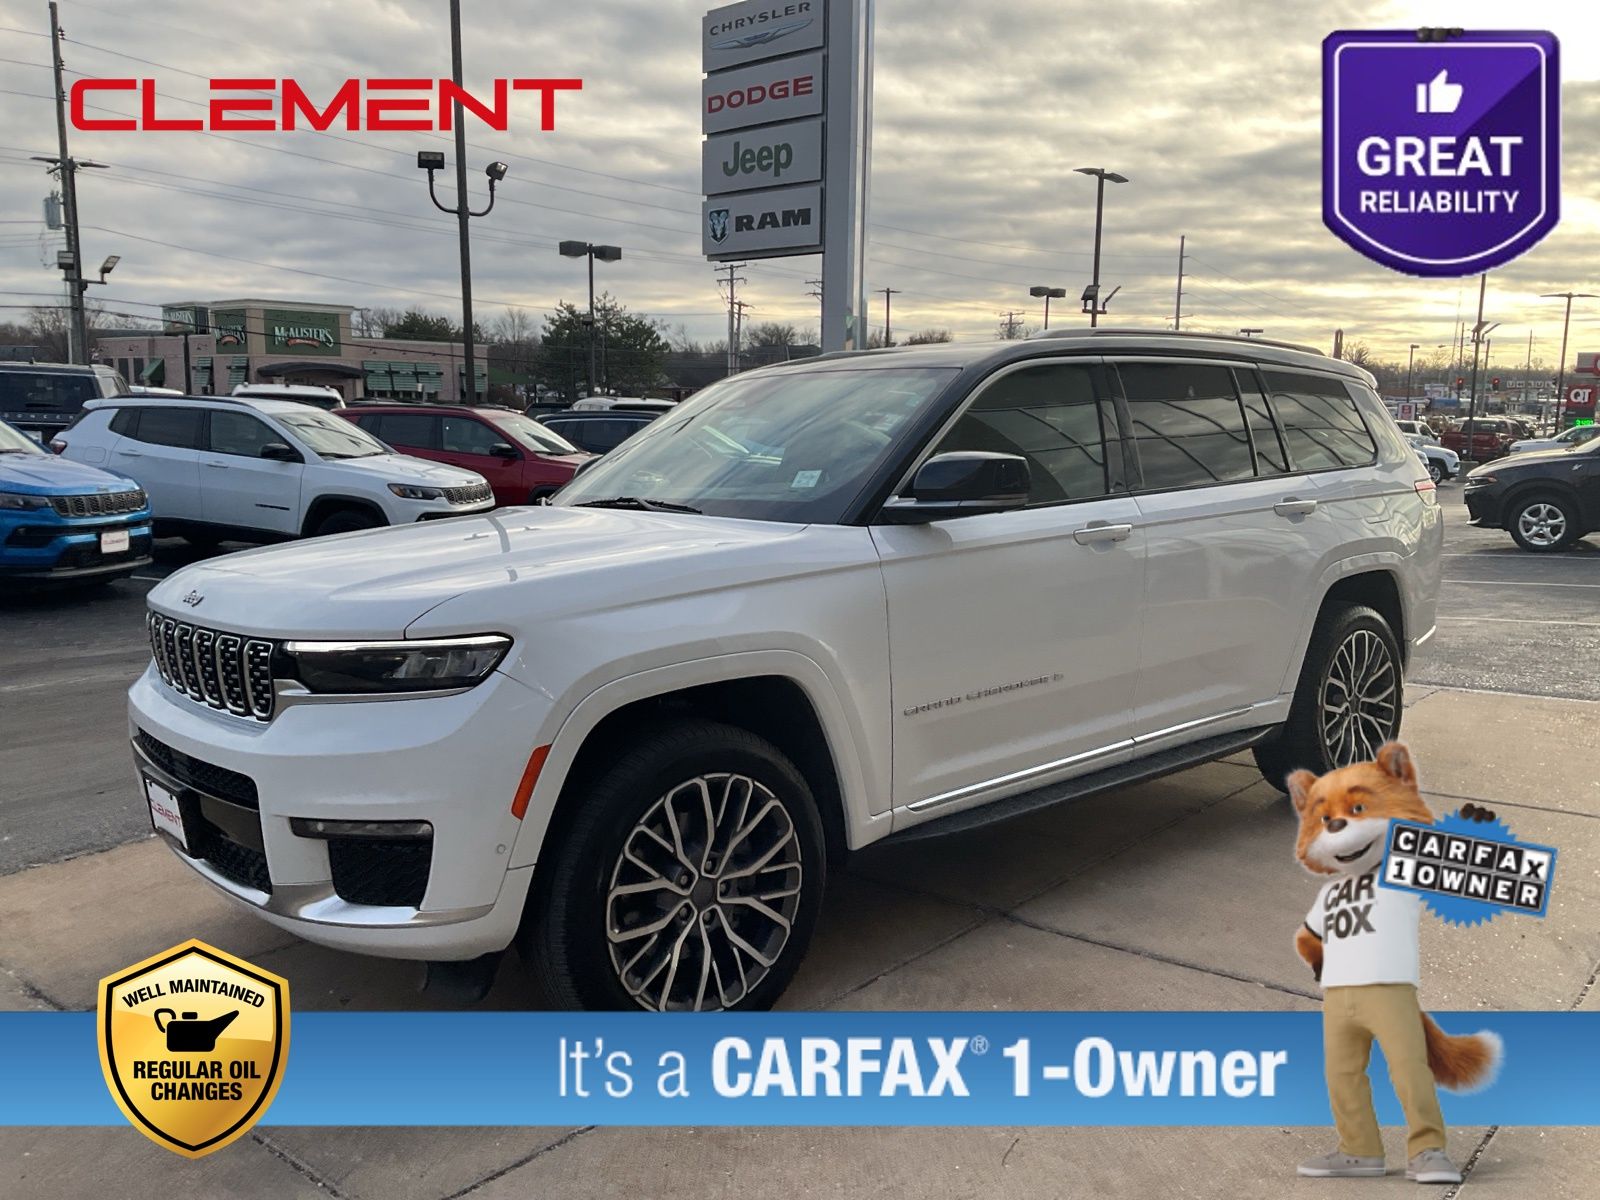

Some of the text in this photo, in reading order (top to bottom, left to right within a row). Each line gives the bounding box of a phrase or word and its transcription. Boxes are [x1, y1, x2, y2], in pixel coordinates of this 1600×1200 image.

[710, 2, 811, 36] CHRYSLER
[707, 75, 813, 114] DODGE
[722, 141, 793, 177] Jeep
[735, 207, 812, 232] RAM
[1570, 388, 1592, 404] QT
